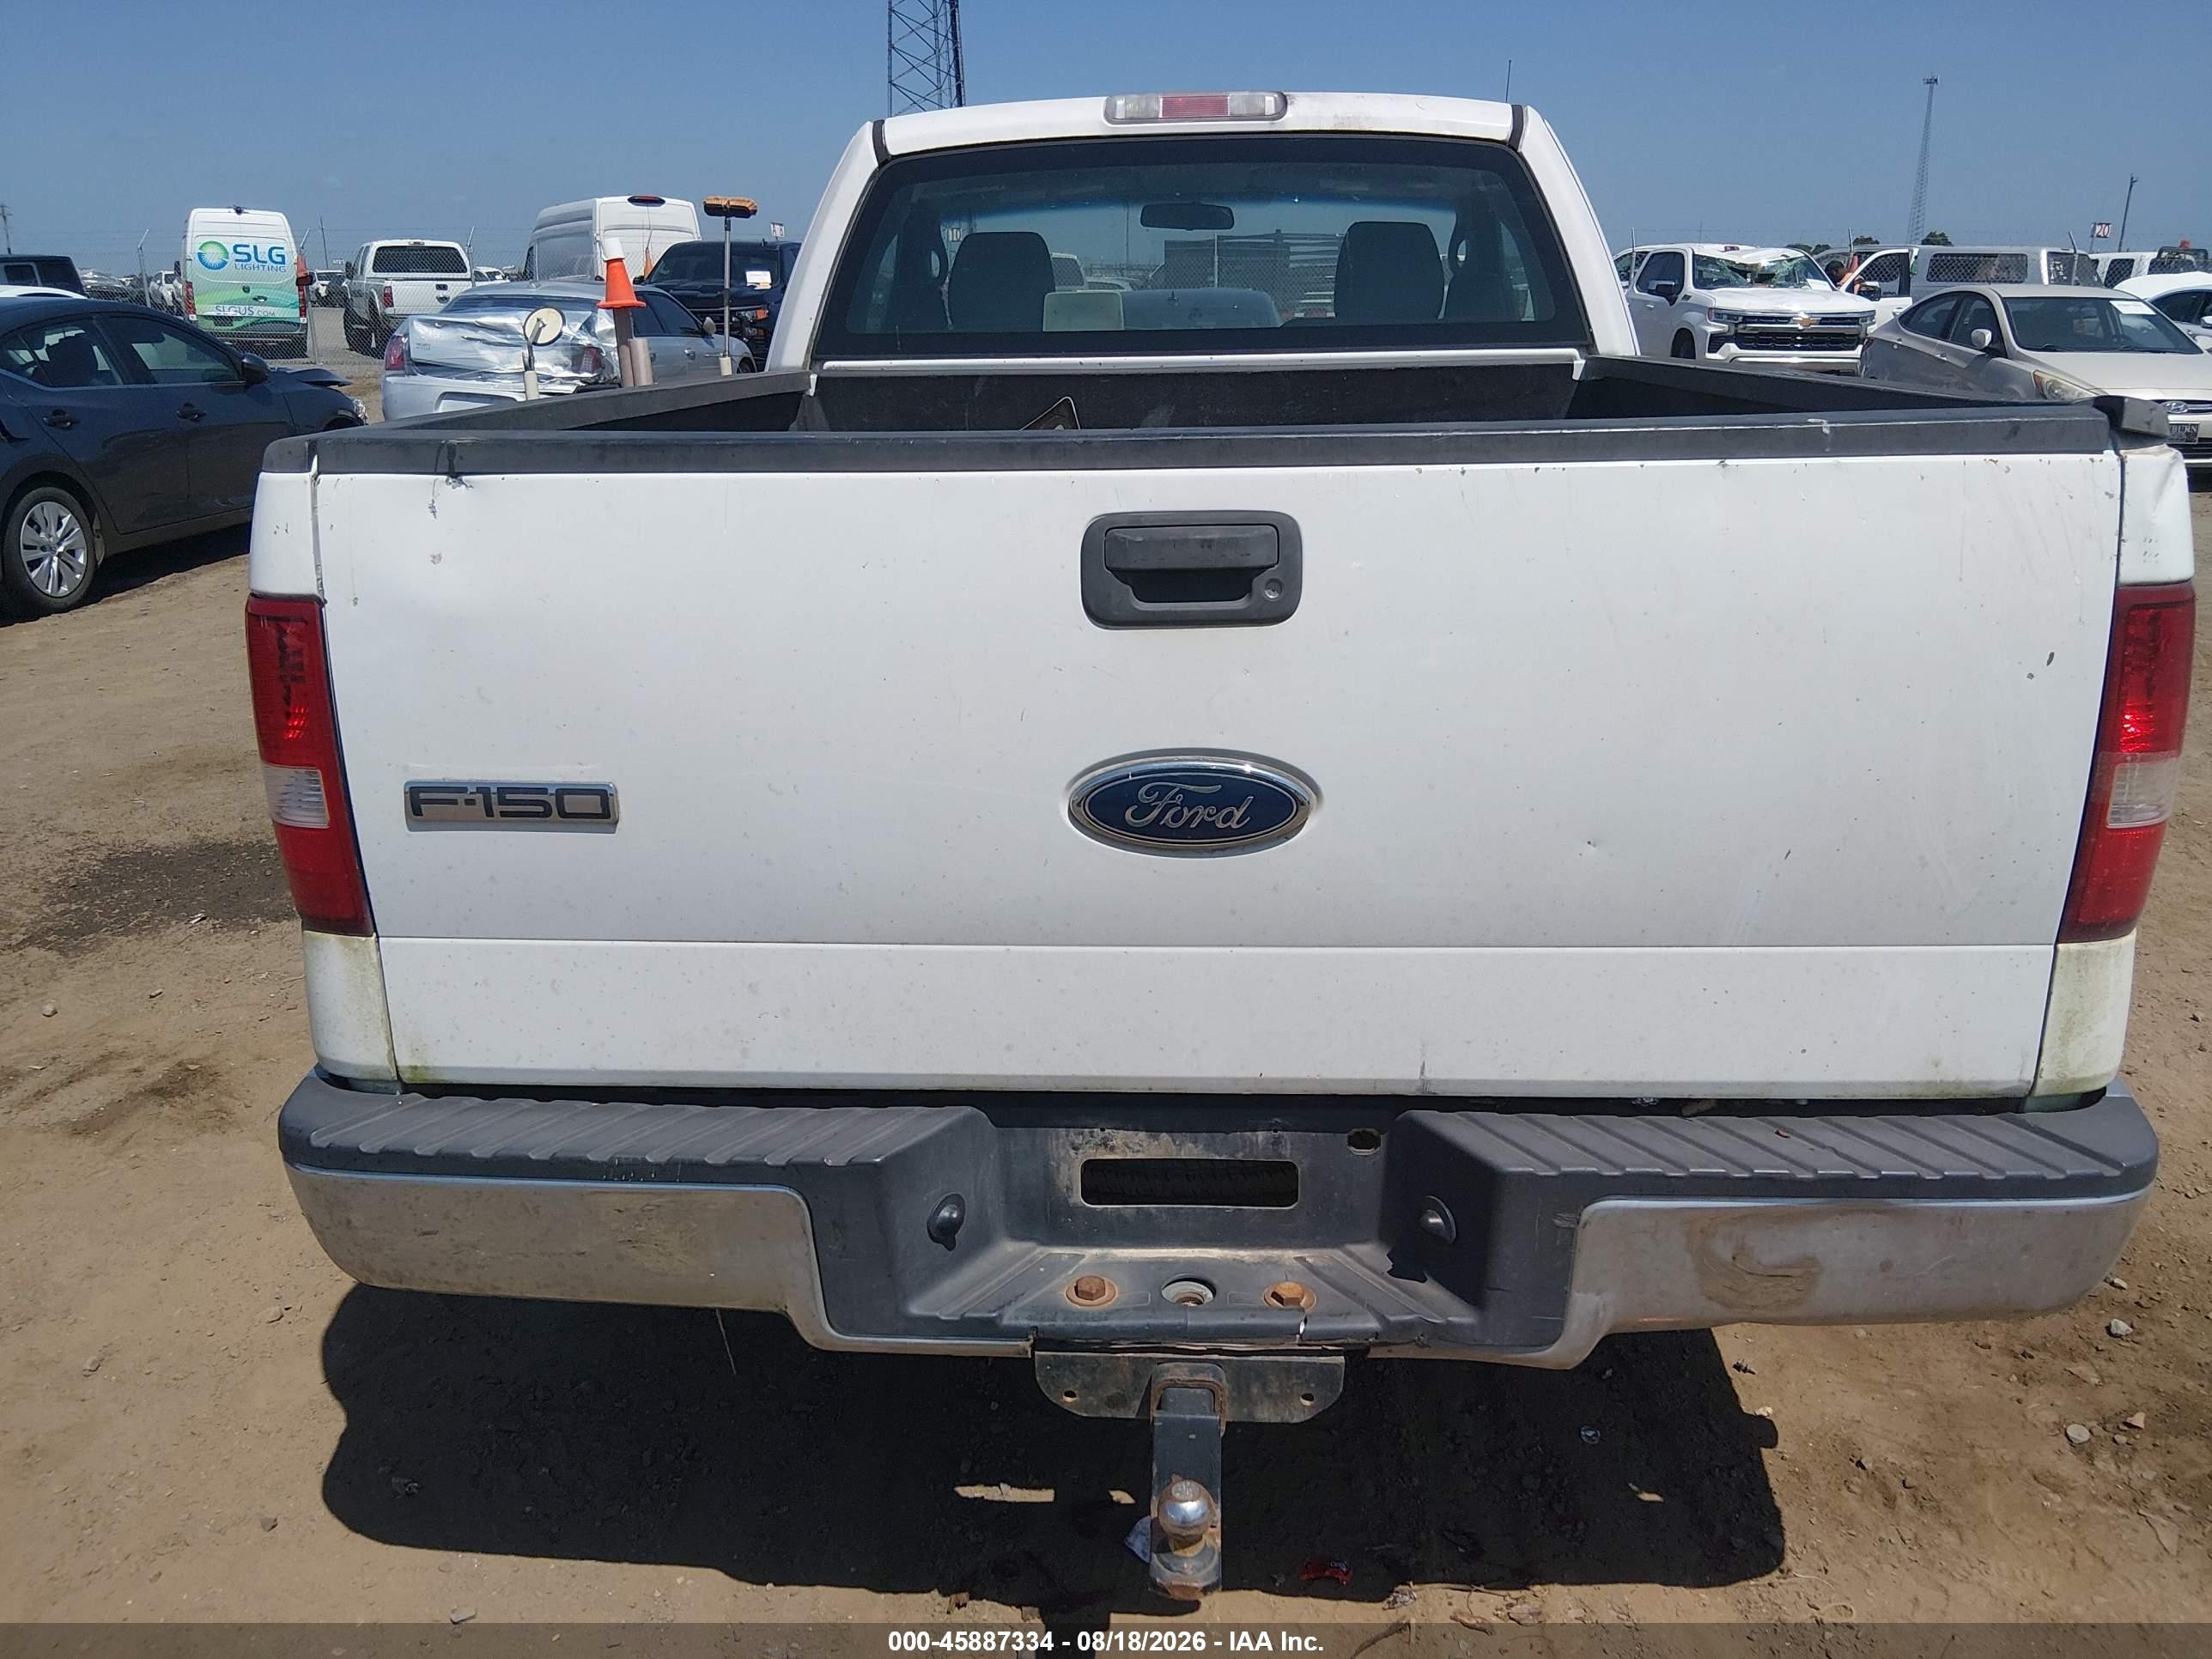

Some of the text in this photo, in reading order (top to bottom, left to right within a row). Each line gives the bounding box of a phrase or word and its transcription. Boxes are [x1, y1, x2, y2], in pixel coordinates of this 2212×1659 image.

[951, 228, 962, 241] 10
[2096, 223, 2110, 238] 20
[233, 244, 286, 265] SLG
[234, 263, 287, 273] LIGHTING
[410, 786, 611, 820] F-150
[1124, 781, 1254, 829] Ford
